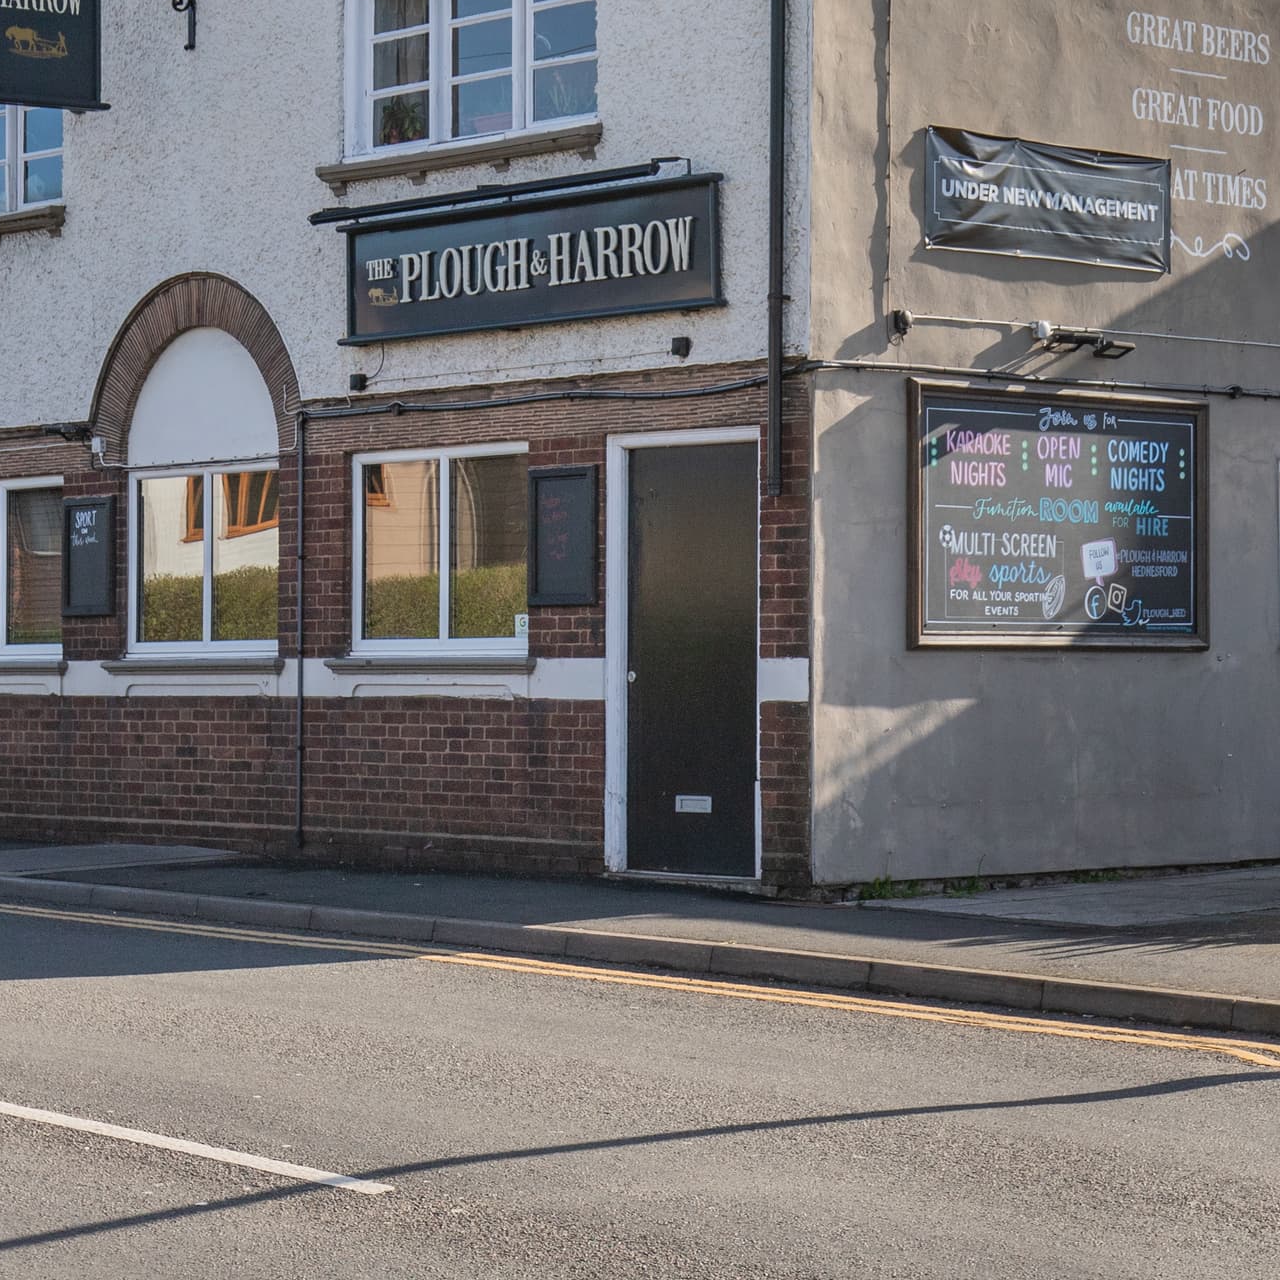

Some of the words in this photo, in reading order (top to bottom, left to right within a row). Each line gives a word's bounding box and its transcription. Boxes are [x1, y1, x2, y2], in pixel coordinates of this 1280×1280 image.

[1126, 11, 1197, 53] GREAT
[1201, 23, 1271, 66] BEERS
[1132, 87, 1202, 128] GREAT
[1206, 99, 1264, 136] FOOD
[941, 178, 999, 204] UNDER
[1004, 186, 1043, 208] NEW
[1045, 191, 1160, 223] MANAGEMENT
[1203, 171, 1267, 210] TIMES
[366, 258, 394, 282] THE
[399, 237, 531, 304] PLOUGH
[530, 249, 549, 276] &
[547, 215, 694, 287] HARROW
[1039, 407, 1078, 431] Join
[946, 430, 1011, 455] KARAOKE
[1037, 435, 1081, 460] OPEN
[1107, 439, 1169, 464] COMEDY
[951, 460, 1006, 487] NIGHTS
[1045, 463, 1072, 488] MIC
[1110, 467, 1165, 492] NIGHTS
[75, 510, 97, 528] SPORT
[972, 496, 1038, 521] Function
[1039, 496, 1099, 524] ROOM
[1104, 498, 1160, 516] available
[1112, 516, 1129, 528] FOR
[1136, 517, 1169, 537] HIRE
[950, 531, 996, 556] MULTI
[1001, 532, 1057, 558] SCREEN
[988, 560, 1052, 590] sports
[1131, 565, 1178, 577] HEDNESFORD
[950, 589, 969, 601] FOR
[972, 590, 986, 601] ALL
[990, 590, 1012, 602] YOUR
[1015, 591, 1053, 603] SPORTING
[985, 606, 1019, 616] EVENTS
